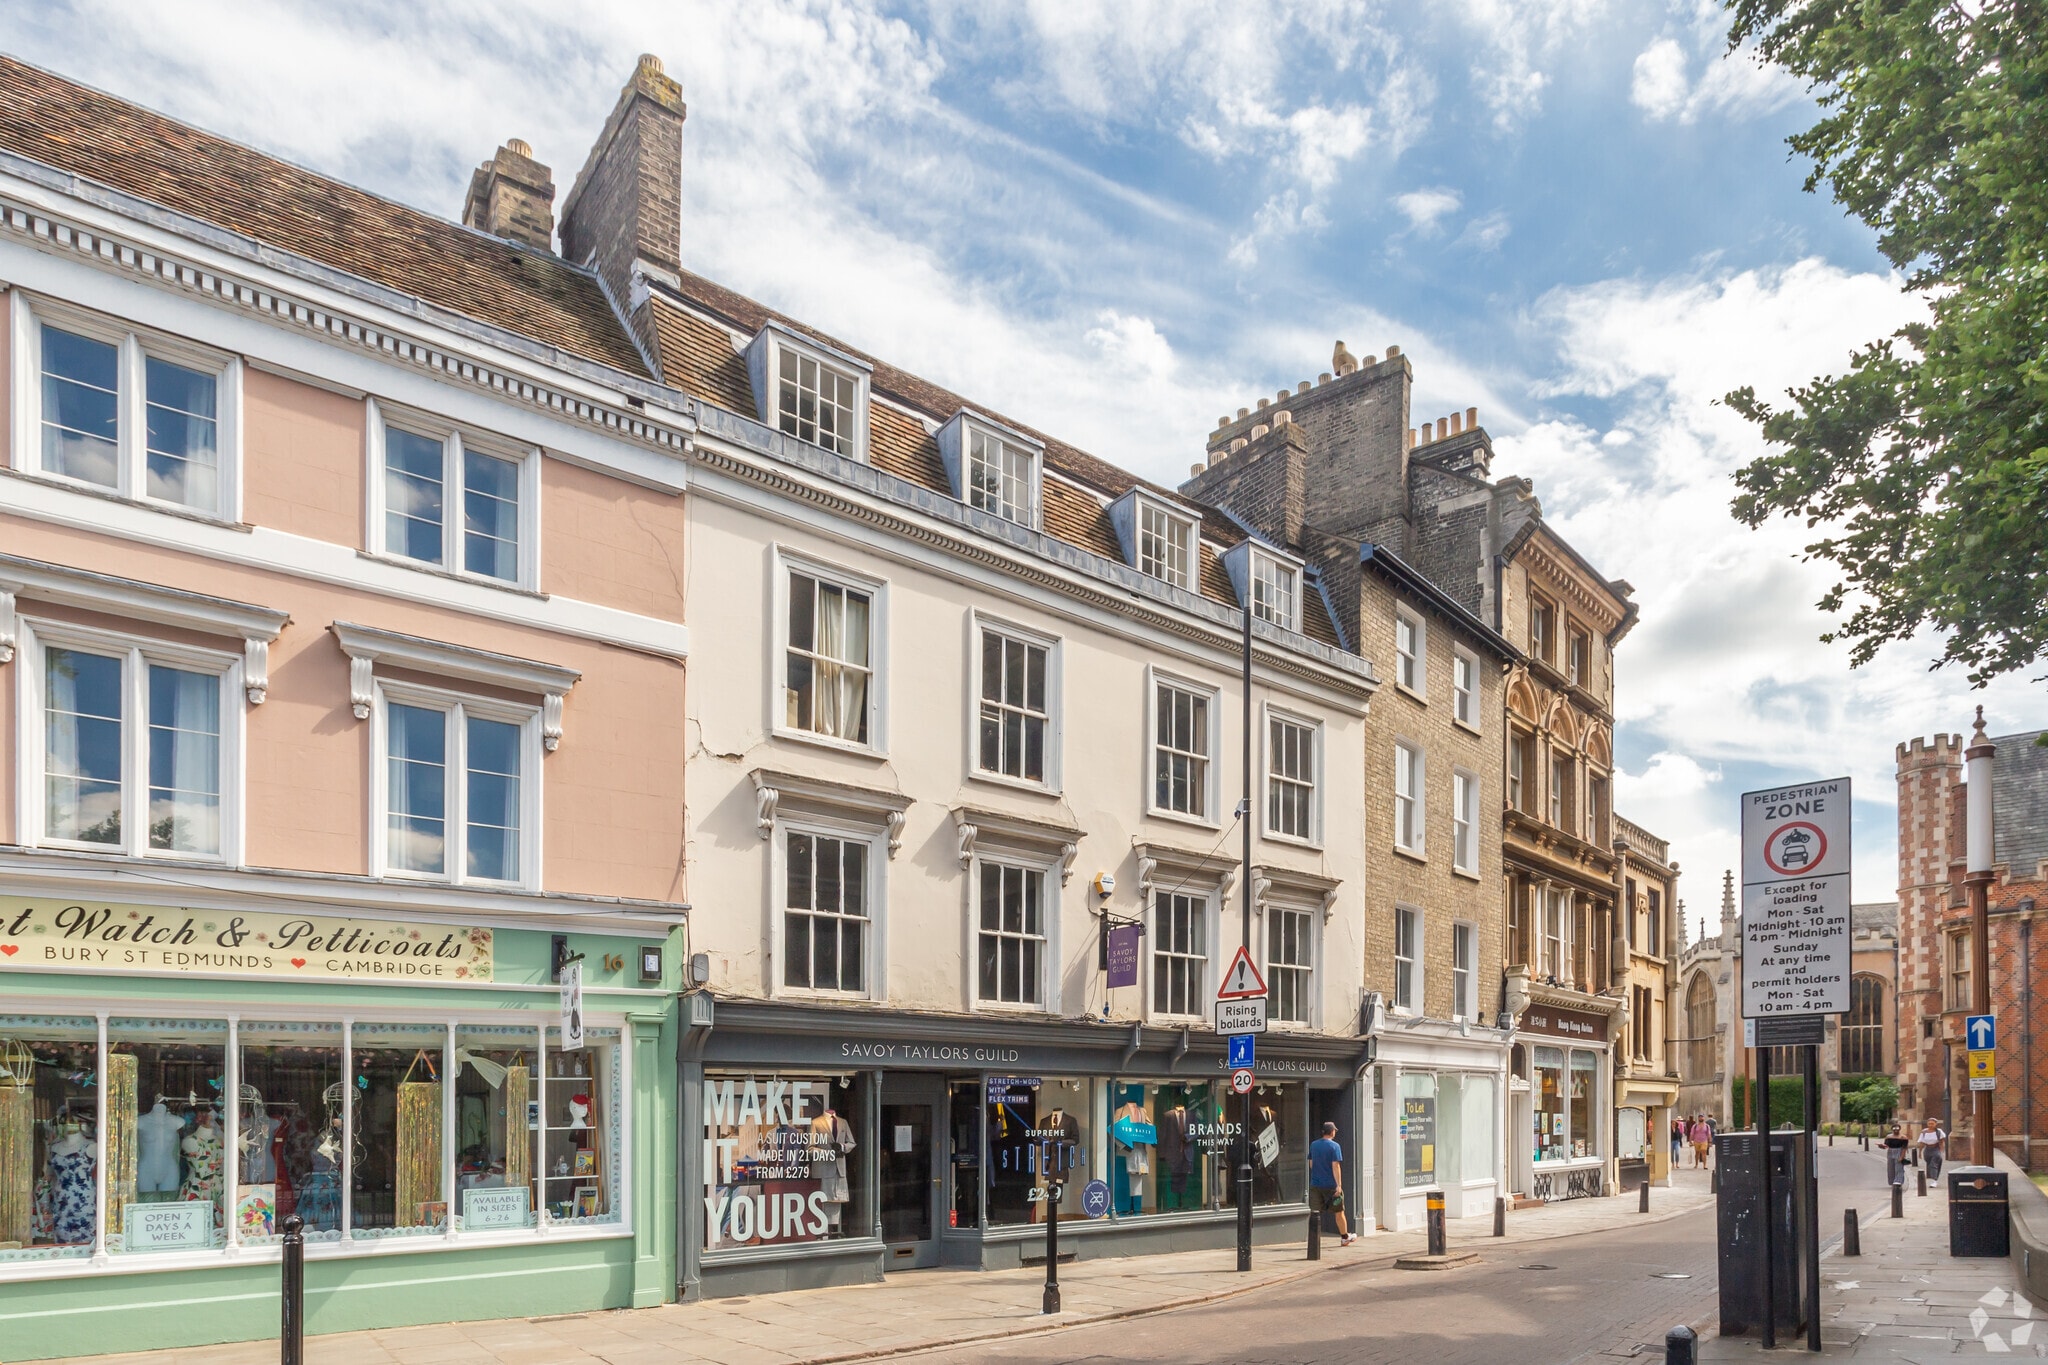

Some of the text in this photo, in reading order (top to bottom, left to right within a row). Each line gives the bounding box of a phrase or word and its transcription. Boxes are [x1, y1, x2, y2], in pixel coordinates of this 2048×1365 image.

[1754, 784, 1838, 805] PEDESTRIAN
[1765, 799, 1825, 820] ZONE
[1765, 882, 1827, 895] Except for
[1774, 894, 1817, 905] loading
[1768, 909, 1793, 919] Mon
[1803, 905, 1824, 915] Sat
[1748, 920, 1800, 932] Midnight
[1810, 917, 1824, 926] 10
[1827, 916, 1845, 925] am
[0, 906, 463, 959] t Watch & Petticoats
[1750, 933, 1758, 943] 4
[1760, 934, 1778, 943] pm
[1788, 926, 1843, 939] Midnight
[1112, 948, 1134, 957] SAVOY
[1773, 942, 1819, 954] Sunday
[45, 946, 273, 969] BURY ST EDMUNDS
[603, 952, 625, 971] 16
[1110, 955, 1136, 966] TAYLORS
[1761, 954, 1831, 966] At any time
[326, 959, 443, 976] CAMBRIDGE
[1784, 965, 1807, 975] and
[1752, 974, 1840, 989] permit holders
[1768, 990, 1793, 1000] Mon
[1803, 988, 1825, 998] Sat
[1225, 1006, 1257, 1017] Rising
[1759, 1003, 1773, 1012] 10
[1776, 1004, 1793, 1012] am
[1802, 1001, 1811, 1009] 4
[1814, 1001, 1833, 1011] pm
[1220, 1017, 1262, 1029] bollards
[1557, 1018, 1569, 1033] Hong
[1569, 1020, 1580, 1035] Kong
[842, 1043, 1019, 1062] SAVOY TAYLORS GUILD
[1256, 1060, 1296, 1071] TAYLORS
[1299, 1061, 1327, 1072] GUILD
[989, 1077, 1041, 1085] STRETCH-WOOL
[1235, 1075, 1251, 1086] 20
[704, 1080, 812, 1126] MAKE
[1406, 1102, 1425, 1113] To Let
[1025, 1129, 1065, 1138] SUPREME
[1189, 1122, 1242, 1136] BRANDS
[757, 1133, 828, 1145] A SUIT CUSTOM
[1197, 1138, 1234, 1147] THIS WAY
[1262, 1135, 1276, 1153] DKNY
[757, 1150, 836, 1161] MADE IN 21 DAYS
[1002, 1140, 1086, 1176] STRETCH
[704, 1139, 738, 1185] IT
[757, 1166, 810, 1179] FROM £279
[472, 1195, 521, 1204] AVAILABLE
[478, 1205, 488, 1213] IN
[145, 1212, 193, 1222] OPEN 7
[704, 1191, 829, 1243] YOURS
[146, 1222, 192, 1232] DAYS A
[152, 1232, 186, 1241] WEEK
